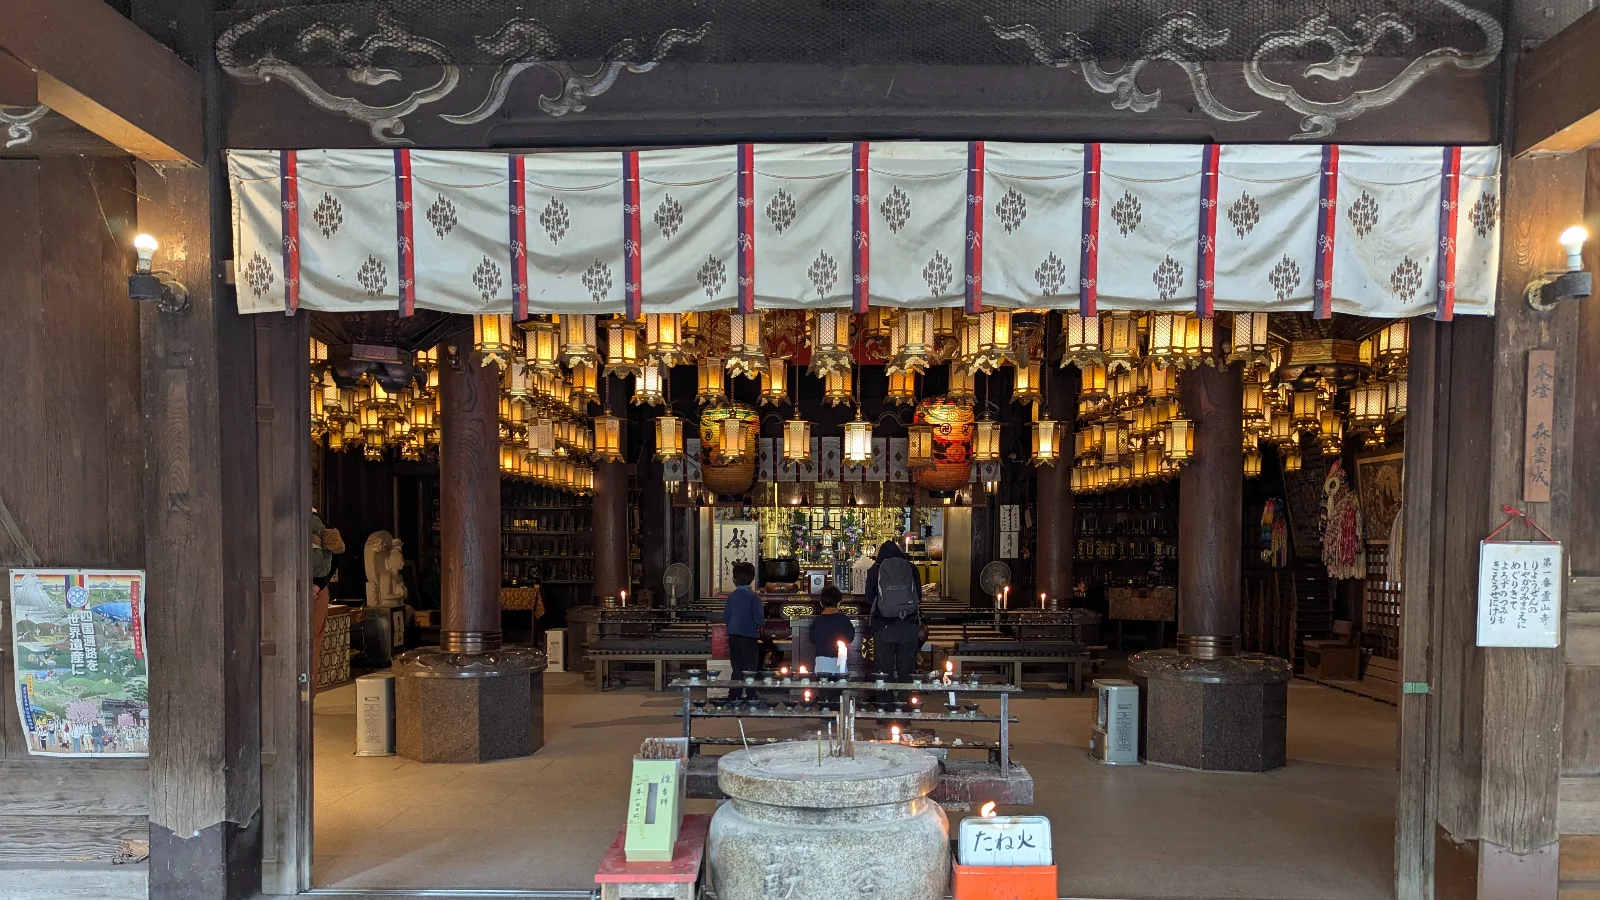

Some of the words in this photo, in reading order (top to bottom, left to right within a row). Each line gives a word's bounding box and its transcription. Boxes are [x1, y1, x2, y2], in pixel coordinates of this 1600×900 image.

[1489, 561, 1500, 625] きえうせにけり
[1498, 561, 1510, 624] よろずのつみも
[1510, 561, 1521, 611] めぐりきて
[67, 614, 85, 676] 世界遺産に
[81, 610, 98, 672] 四国遍路を
[973, 828, 1036, 852] たね火
